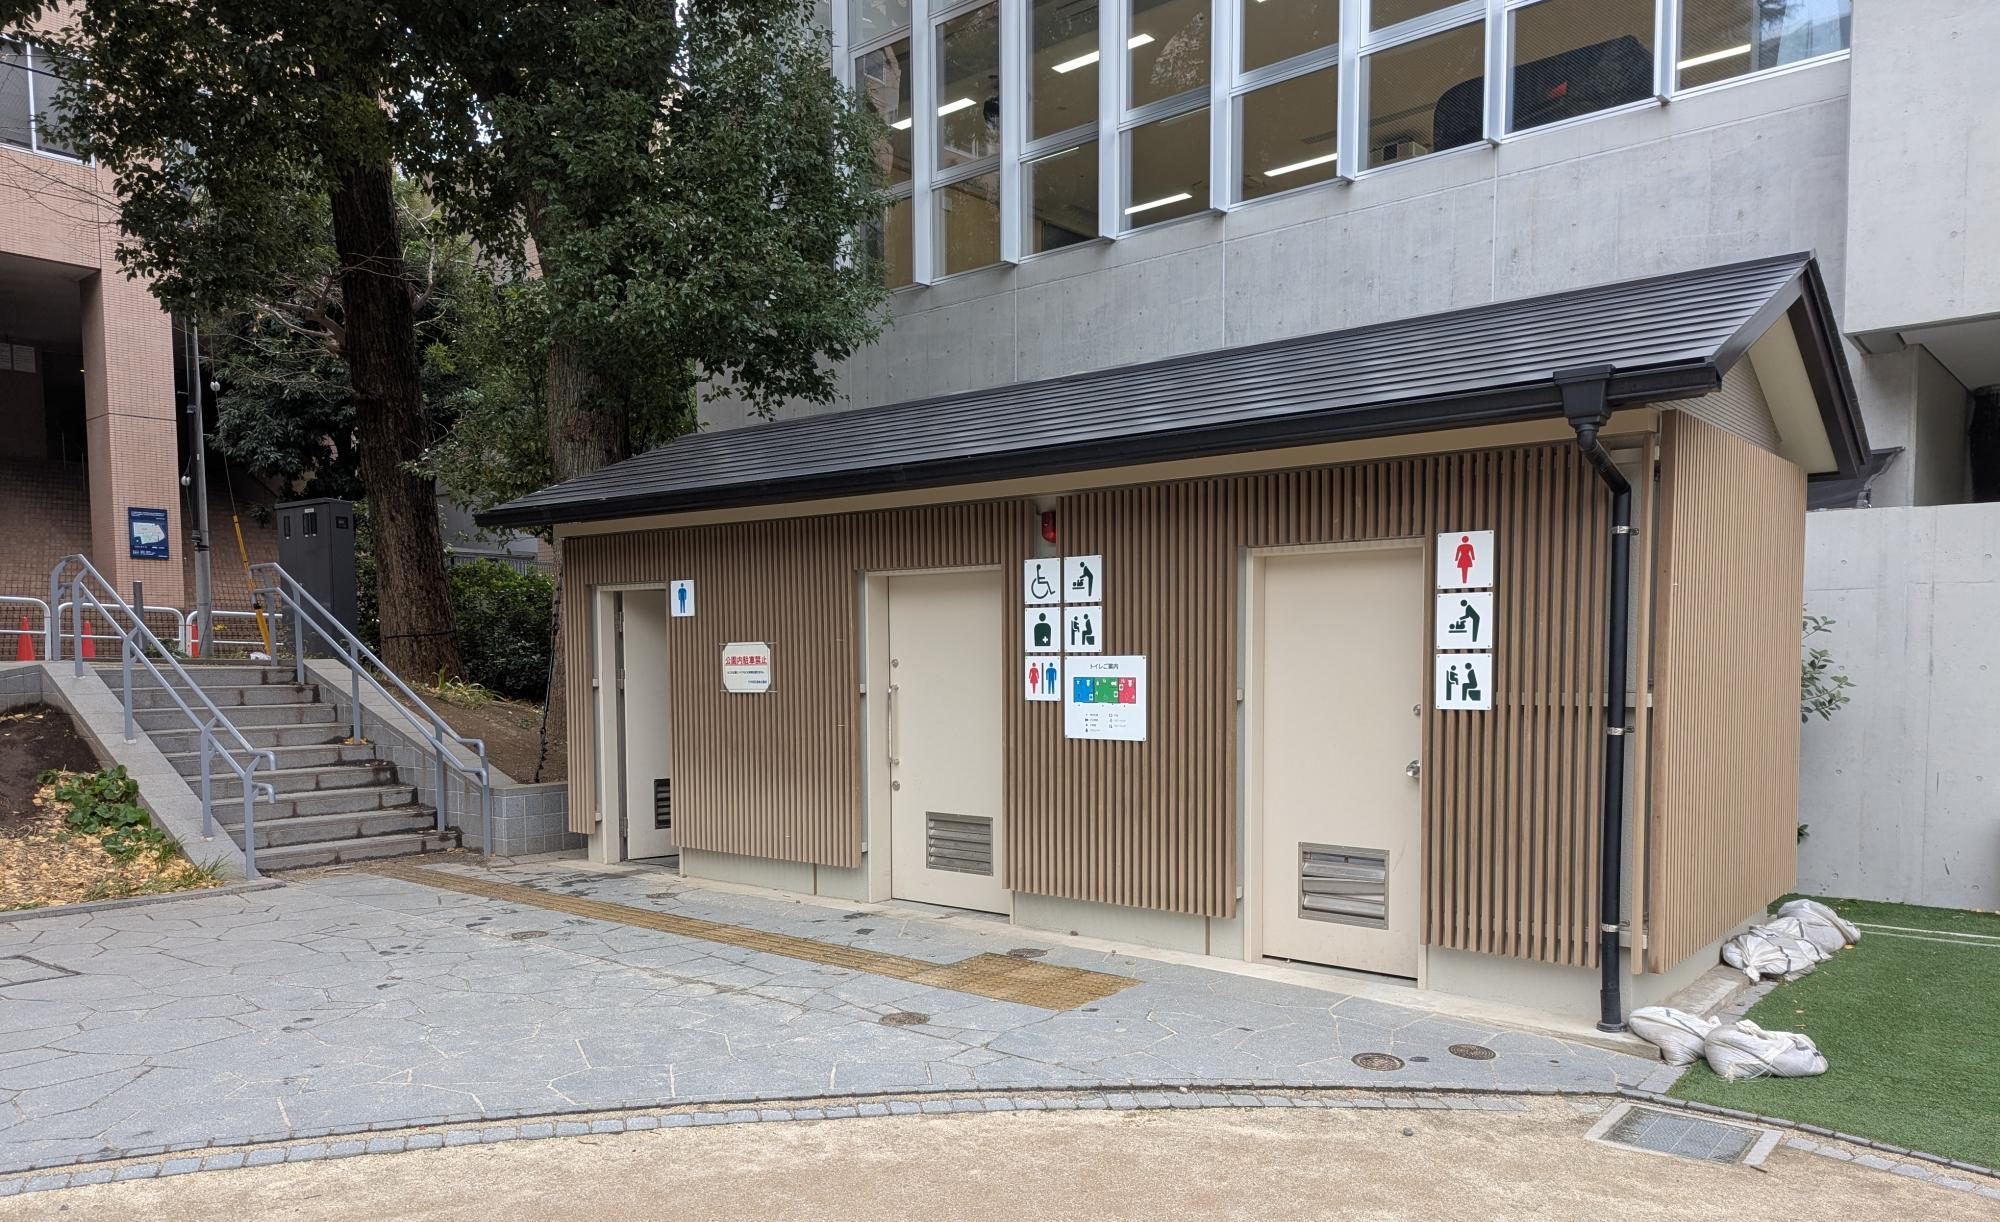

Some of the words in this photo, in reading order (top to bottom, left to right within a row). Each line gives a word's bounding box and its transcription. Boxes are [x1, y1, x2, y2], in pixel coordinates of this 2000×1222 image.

[725, 655, 768, 665] 公園内駐車禁止
